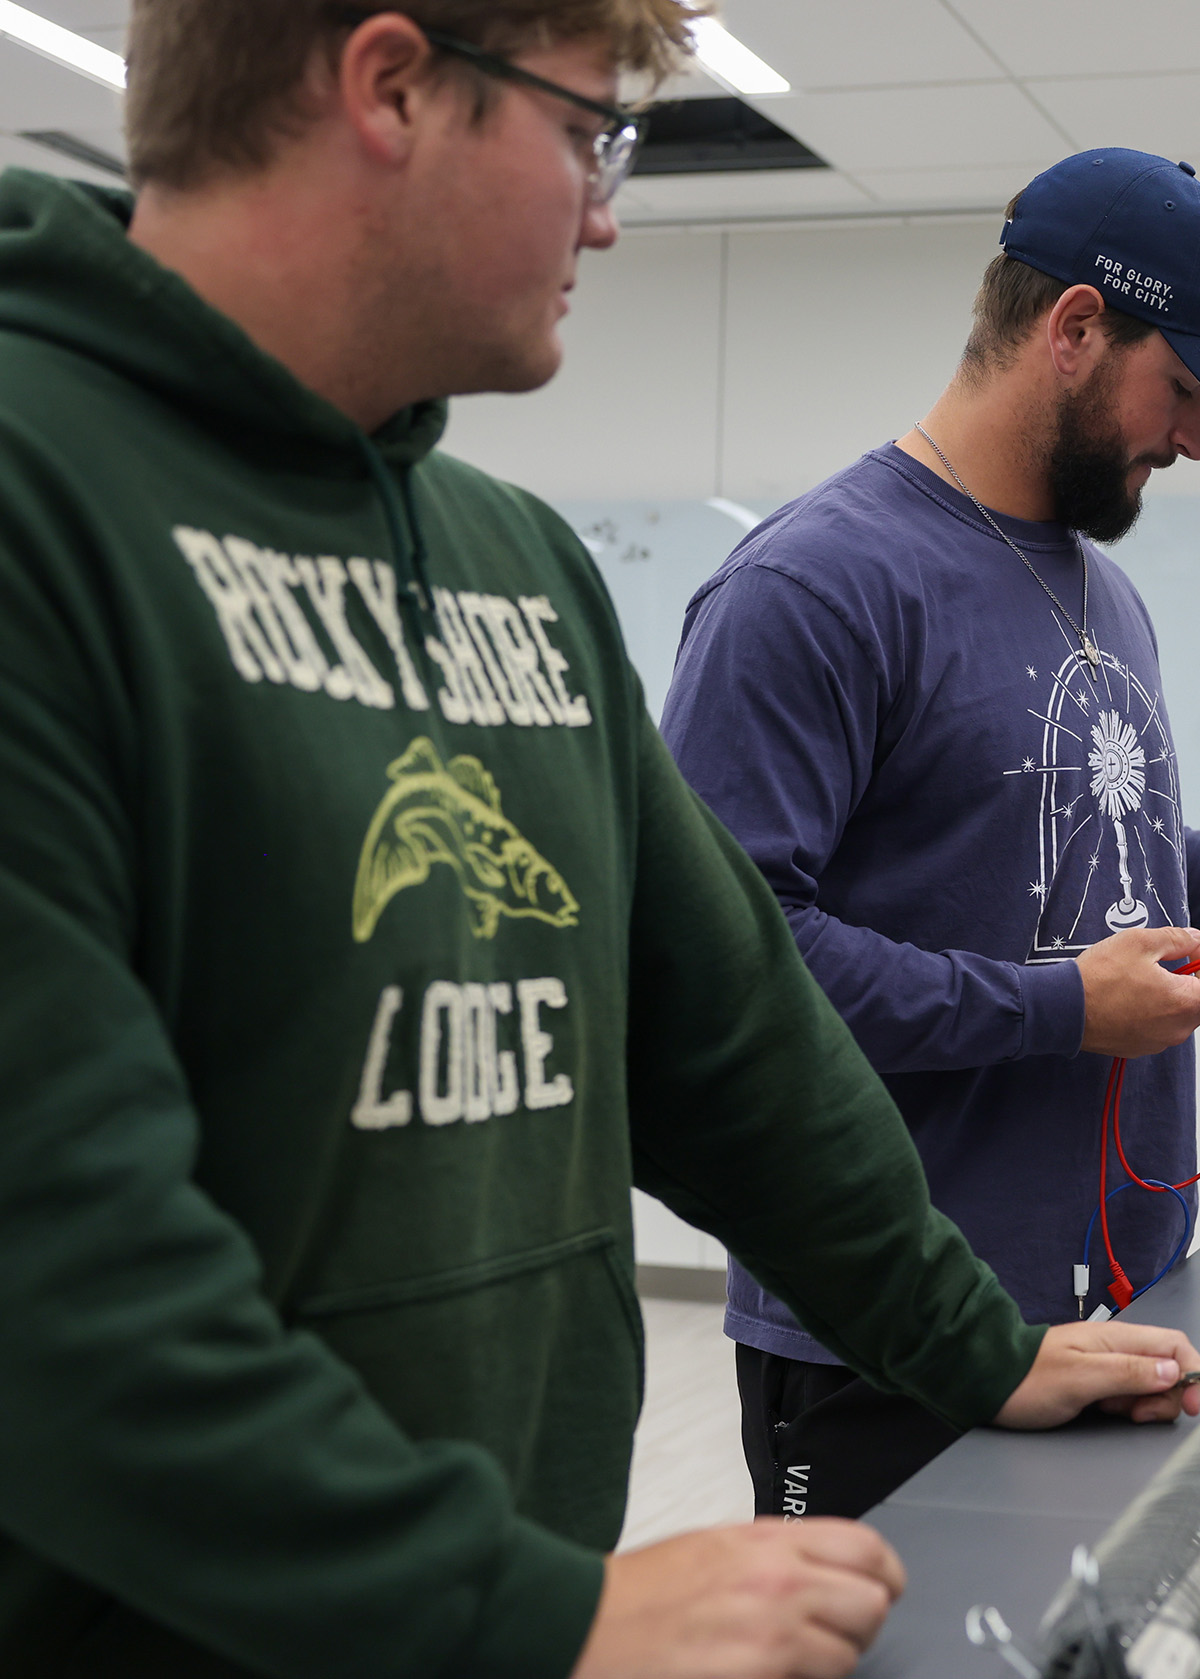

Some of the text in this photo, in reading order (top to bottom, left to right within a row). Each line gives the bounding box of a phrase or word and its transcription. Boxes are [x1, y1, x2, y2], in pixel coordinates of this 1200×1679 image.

[1094, 254, 1174, 299] FOR GLORY.
[1103, 273, 1169, 312] FOR CITY.
[171, 524, 431, 712] ROCKY
[350, 977, 575, 1131] LODGE
